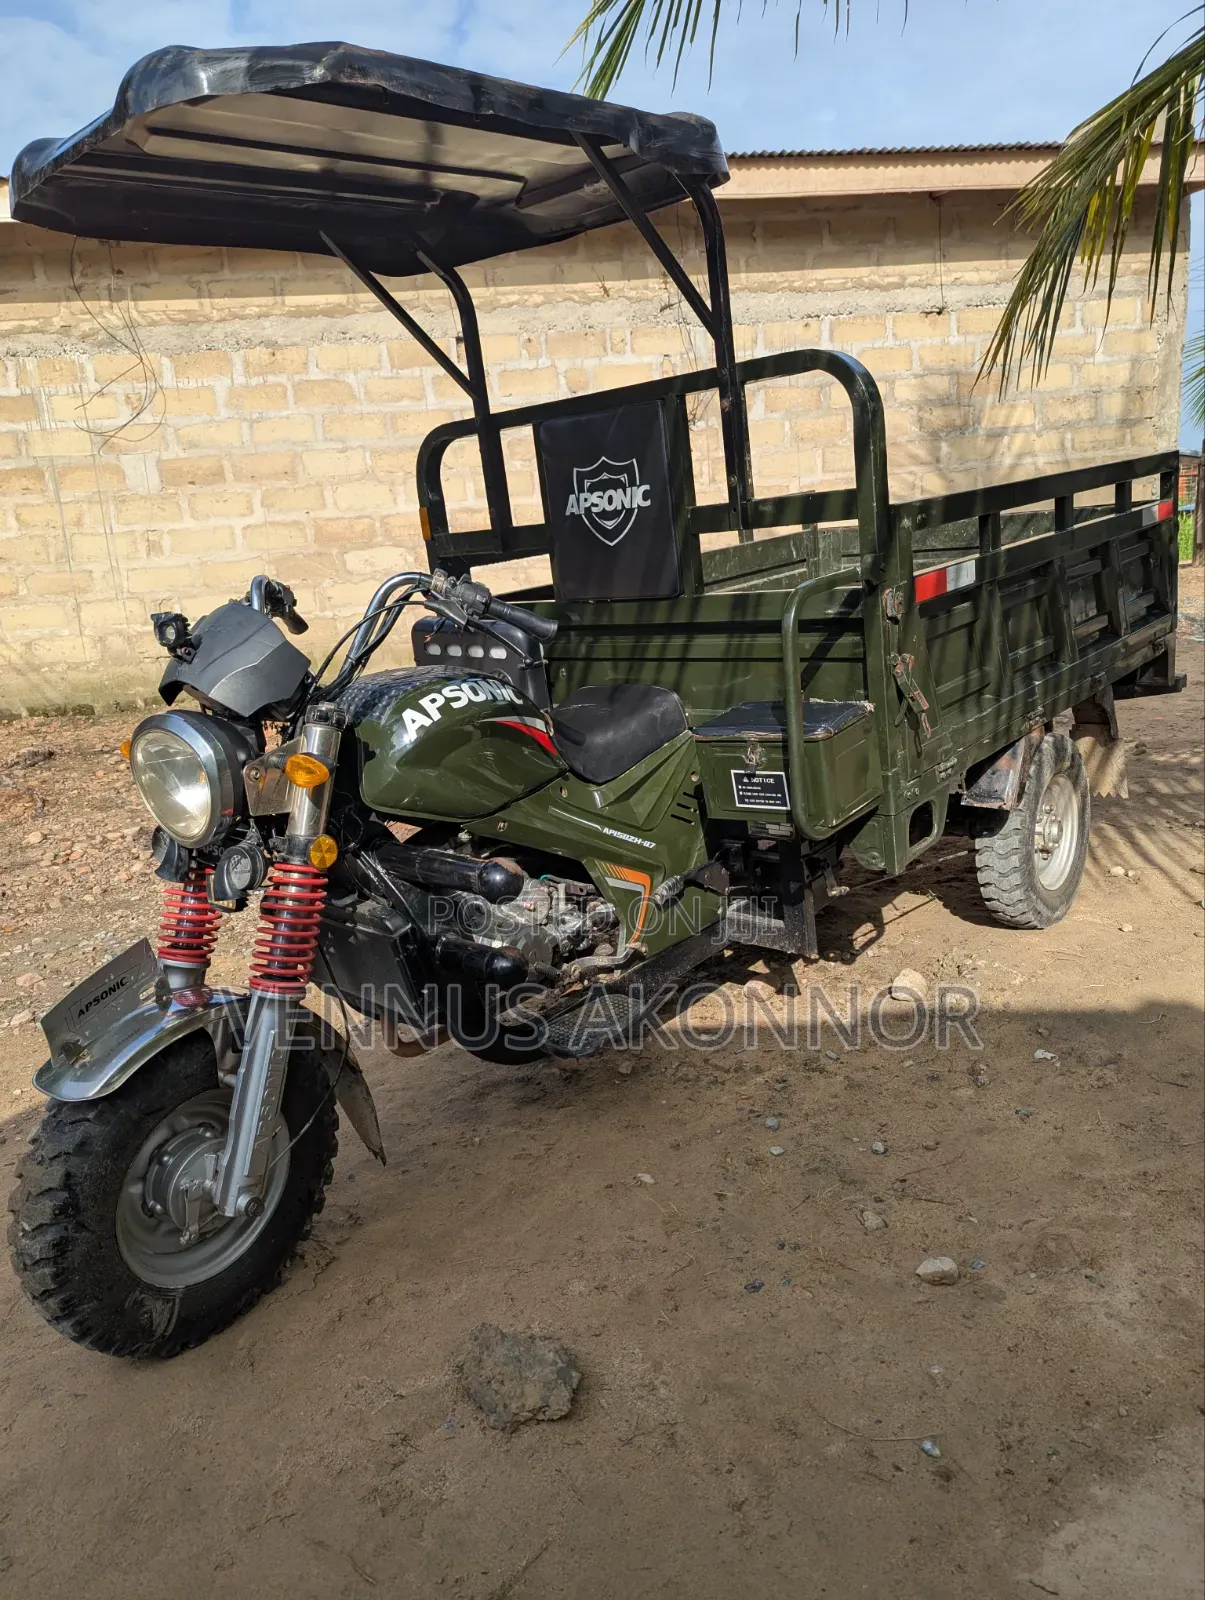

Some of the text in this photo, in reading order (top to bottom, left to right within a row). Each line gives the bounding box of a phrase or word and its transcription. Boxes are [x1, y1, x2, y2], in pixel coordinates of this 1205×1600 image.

[565, 485, 651, 515] APSONIC
[402, 678, 524, 743] APSONIC
[77, 976, 128, 1019] APSONIC
